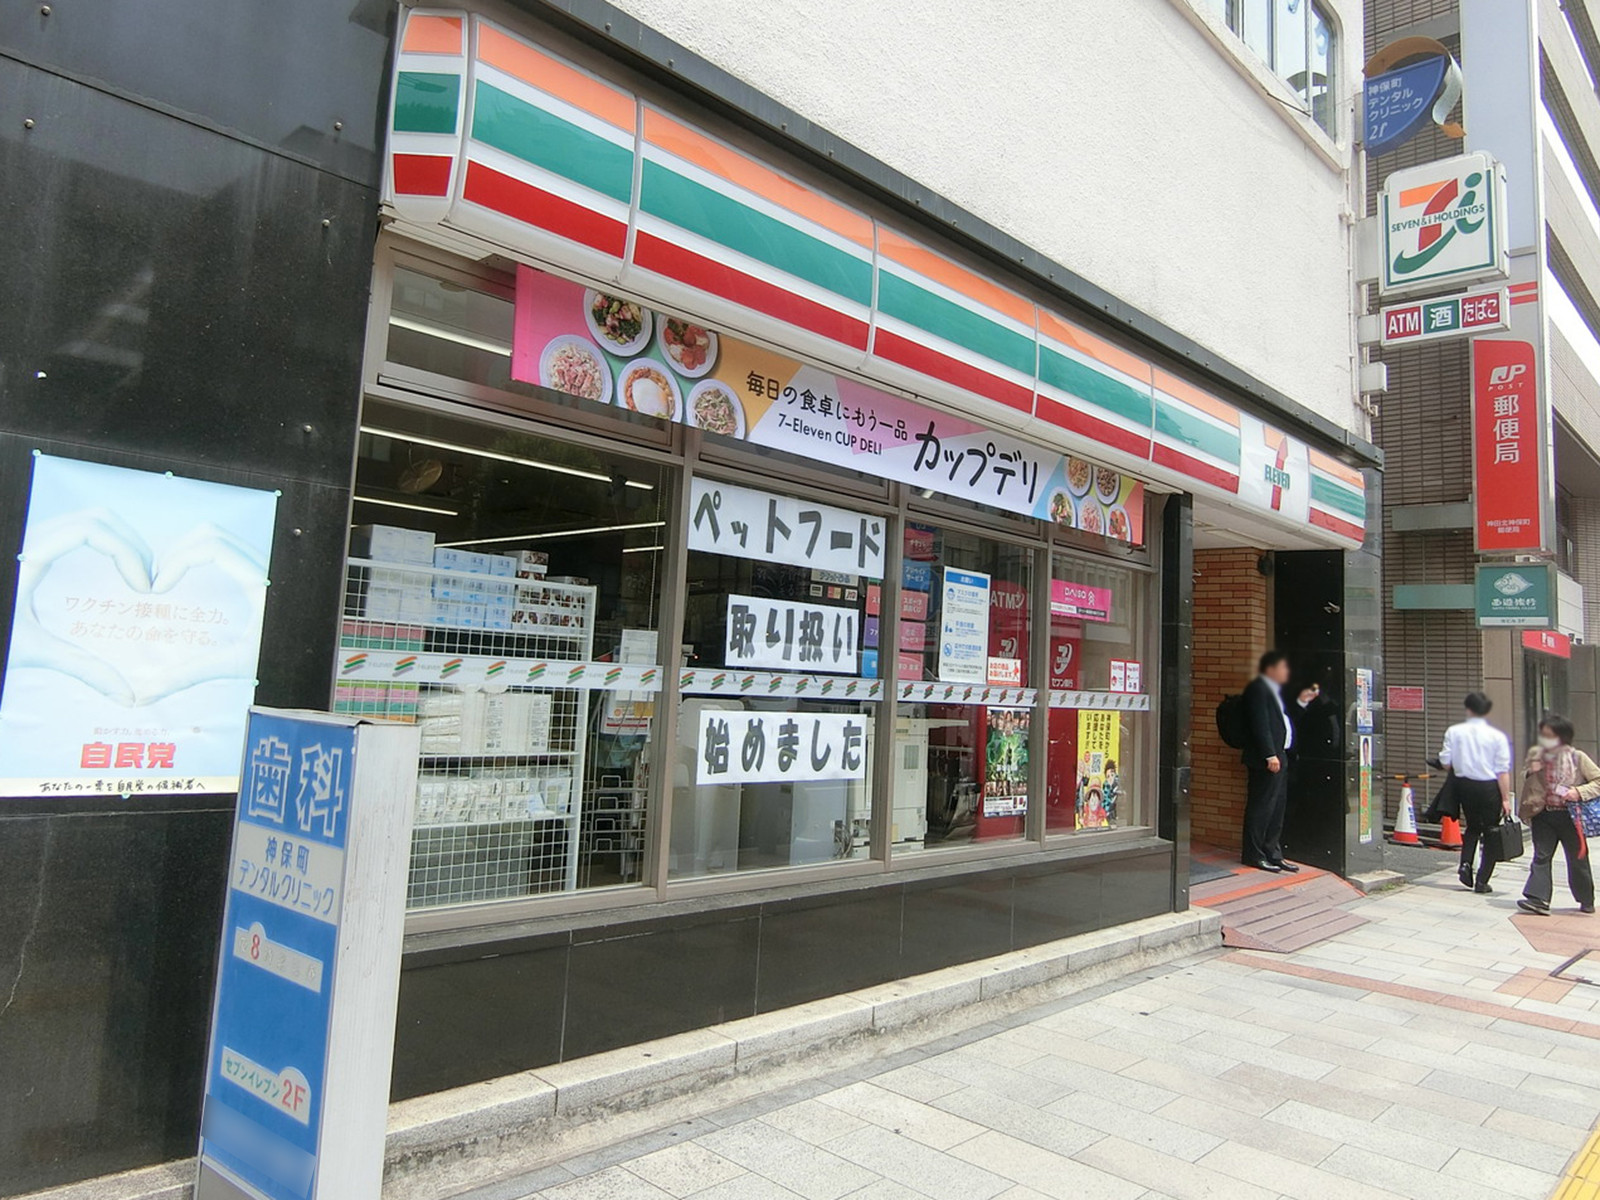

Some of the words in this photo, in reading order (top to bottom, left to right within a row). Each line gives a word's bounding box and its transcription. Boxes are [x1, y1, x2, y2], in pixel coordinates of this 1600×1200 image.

[1368, 77, 1402, 97] 神保町
[1368, 88, 1413, 109] デンタル
[1368, 97, 1423, 121] クリニック
[1434, 203, 1486, 225] HOLDINGS
[1388, 311, 1419, 335] ATM
[1430, 305, 1452, 329] 酒
[1463, 299, 1498, 323] たばこ
[1488, 382, 1524, 392] POST
[747, 370, 908, 442] 毎日の食卓にもう一品
[914, 420, 1039, 504] カップデリ
[778, 413, 832, 443] 7-Eleven
[835, 430, 858, 449] CUP
[860, 436, 882, 456] DELI
[1493, 394, 1521, 465] 郵便局
[694, 490, 881, 568] ペットフード
[65, 597, 230, 626] ワクチン接種に全力。
[989, 590, 1016, 610] ATM
[70, 619, 218, 647] あなたの命を守る。
[730, 604, 853, 663] 取り扱い
[80, 742, 176, 769] 自民党
[704, 717, 862, 776] 始めました
[248, 735, 344, 838] 歯科
[265, 836, 310, 876] 神保町
[239, 859, 335, 916] デンタルクリニック
[224, 1056, 280, 1098] セブンイレブン
[282, 1079, 306, 1112] 2F
